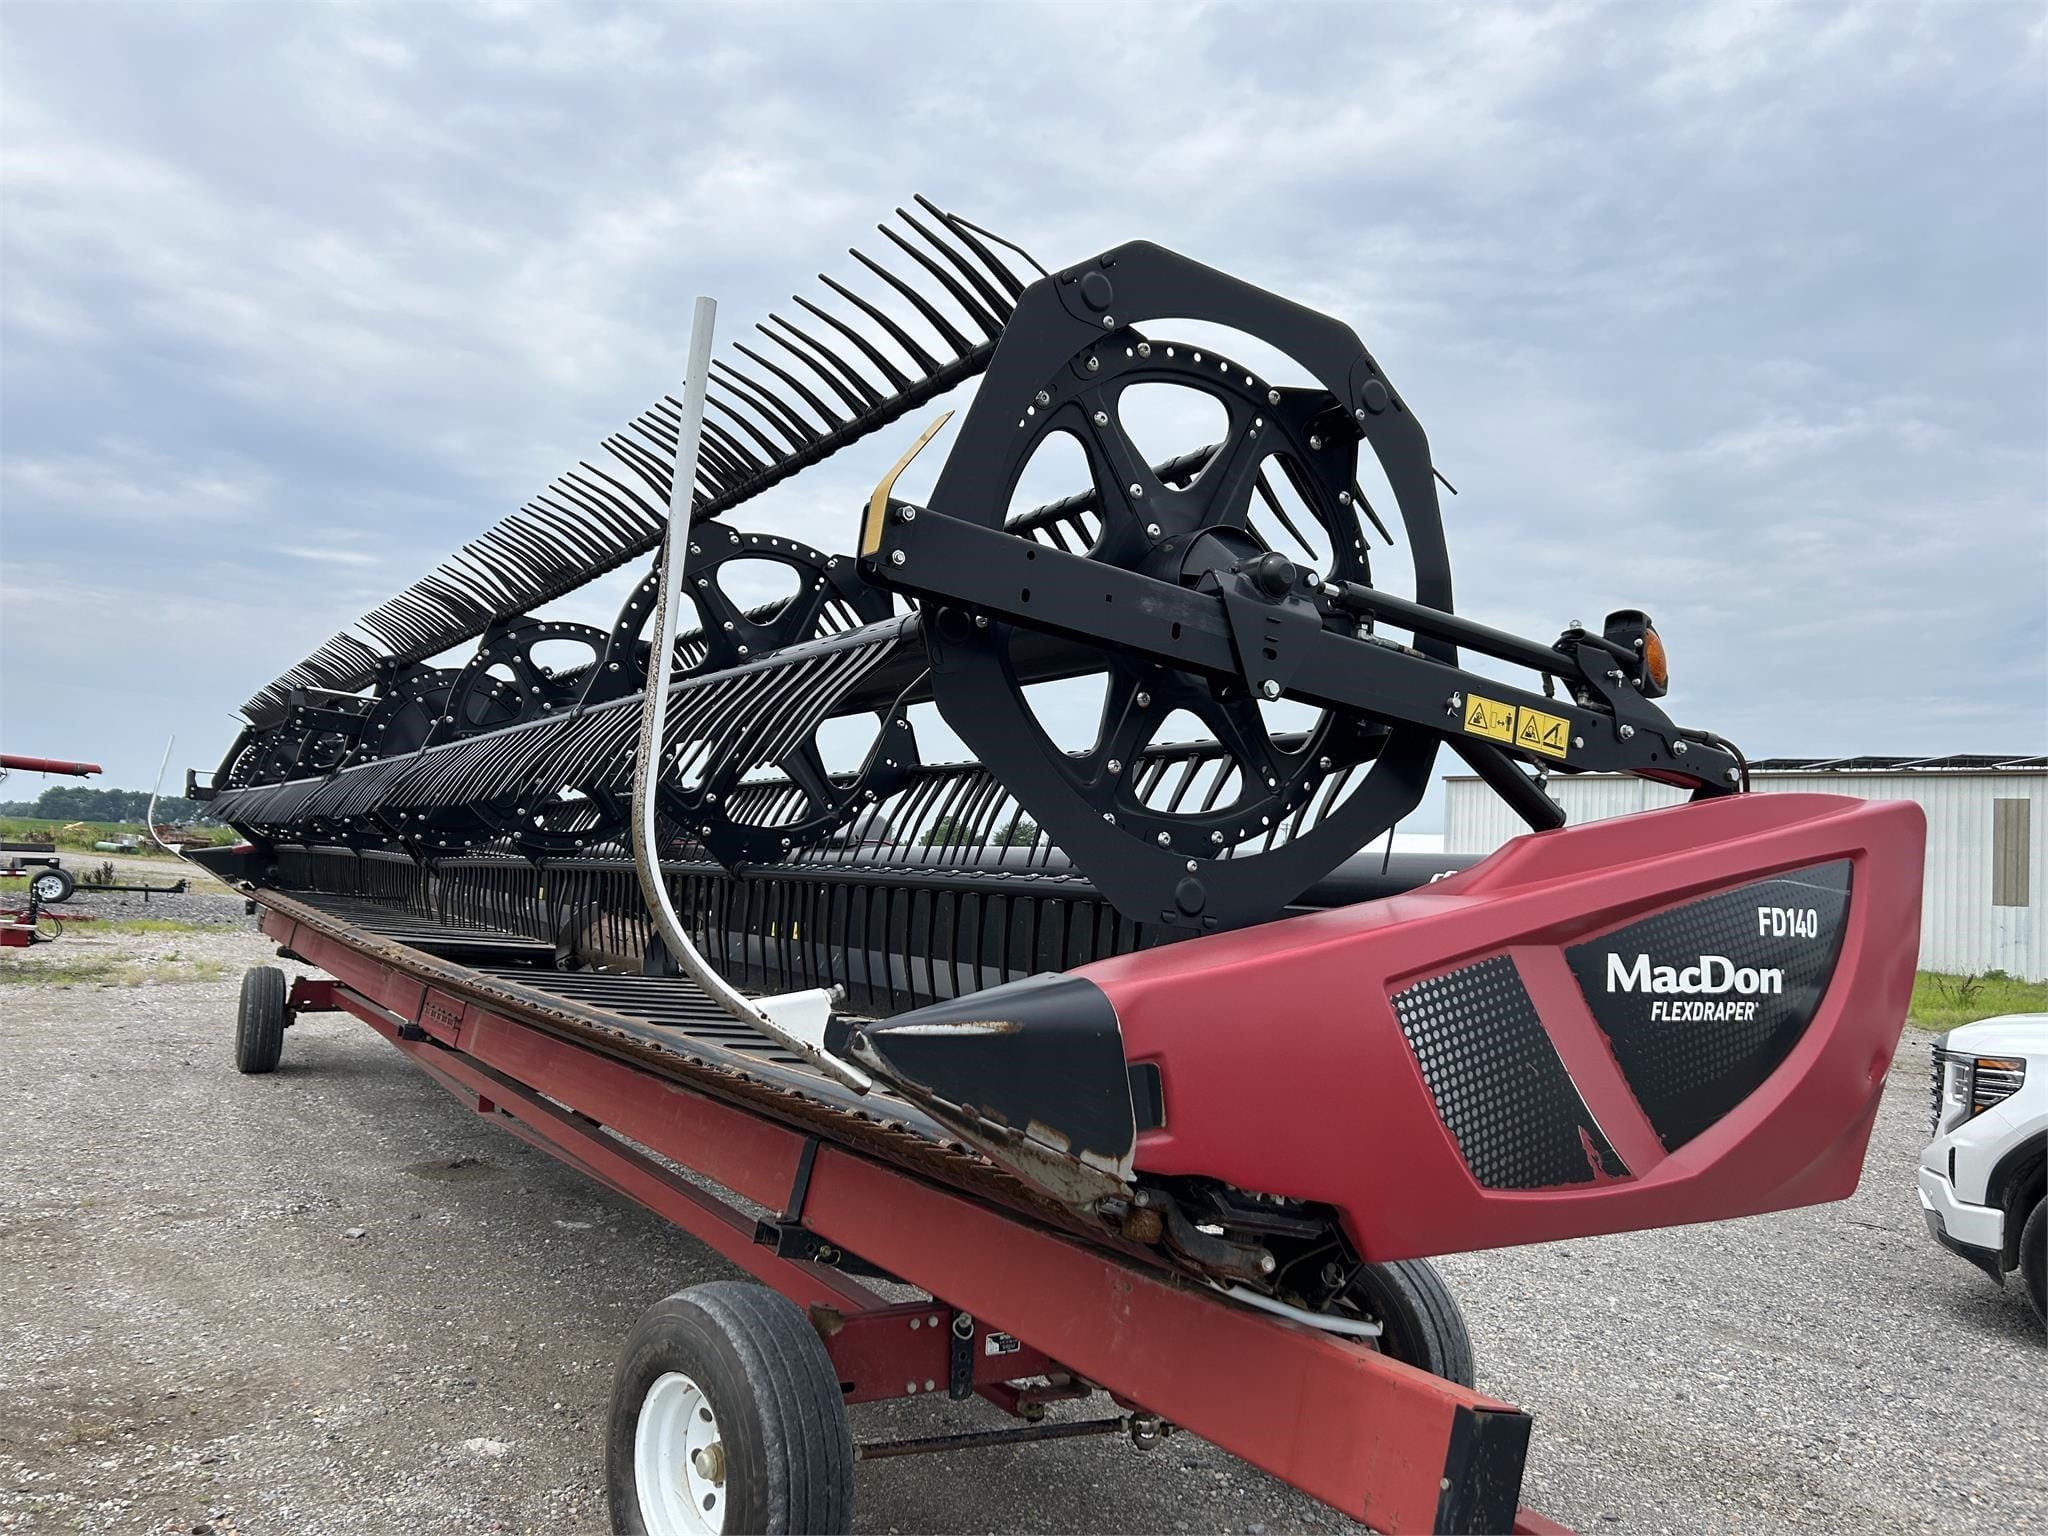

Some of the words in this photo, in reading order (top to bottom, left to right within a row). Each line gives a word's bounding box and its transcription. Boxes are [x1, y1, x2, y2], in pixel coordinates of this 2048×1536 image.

[1758, 906, 1818, 938] FD140
[1606, 953, 1783, 994] MacDon
[1651, 1001, 1755, 1022] FLEXDRAPER
